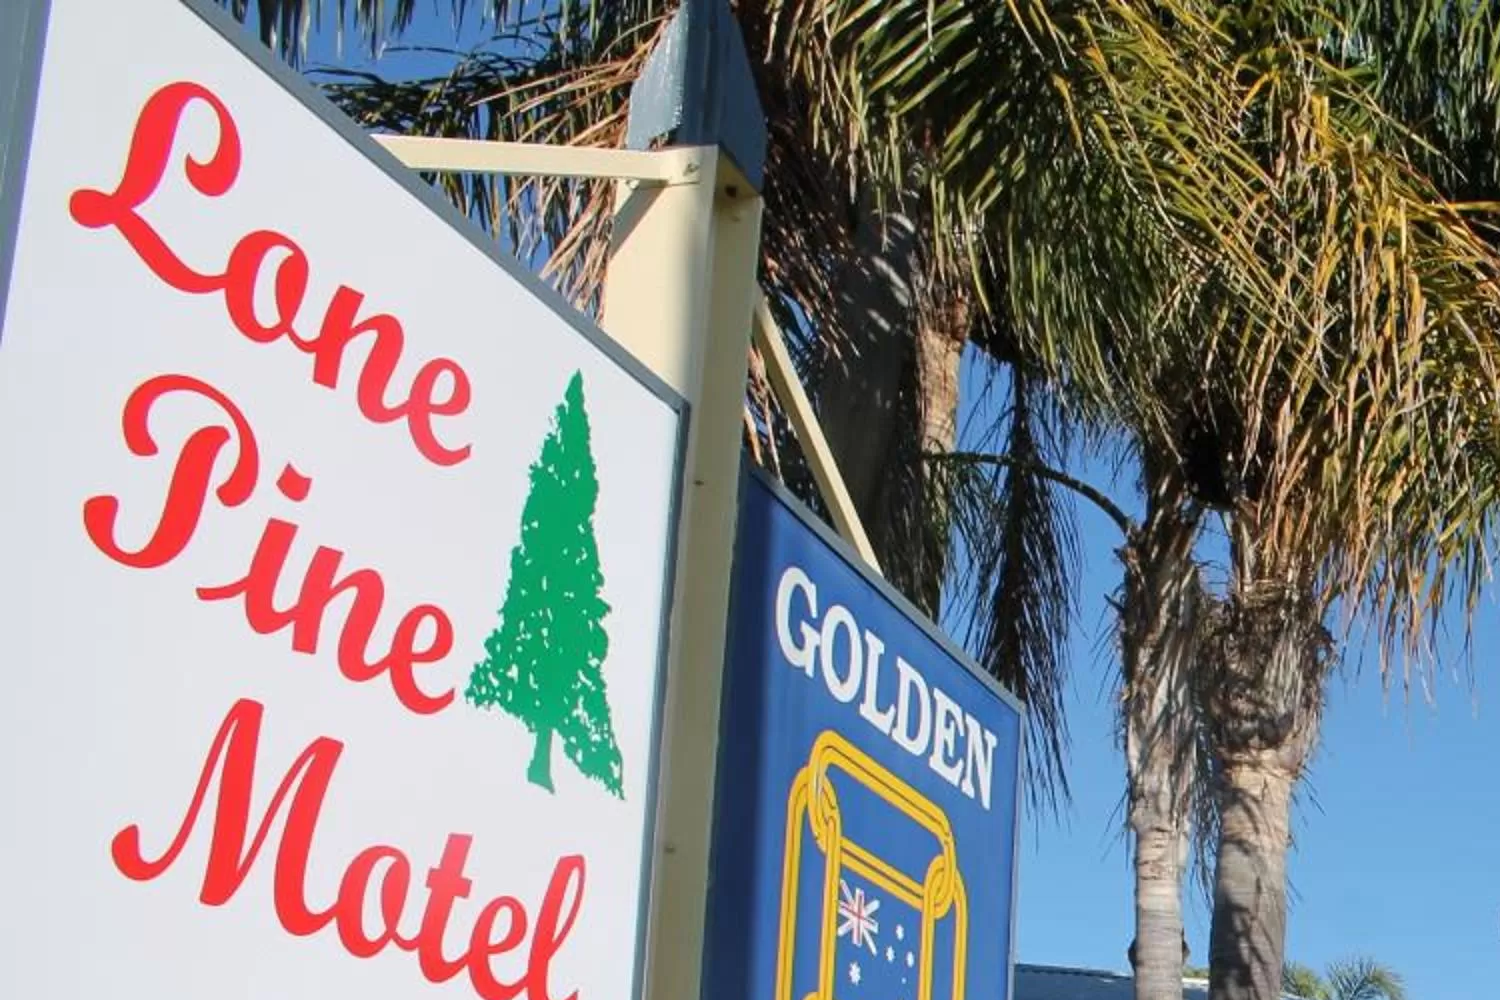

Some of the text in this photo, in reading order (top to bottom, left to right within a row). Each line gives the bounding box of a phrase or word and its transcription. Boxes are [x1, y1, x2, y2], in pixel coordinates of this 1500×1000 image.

[69, 82, 472, 466] Lone
[83, 374, 455, 715] Pine
[775, 566, 997, 810] GOLDEN
